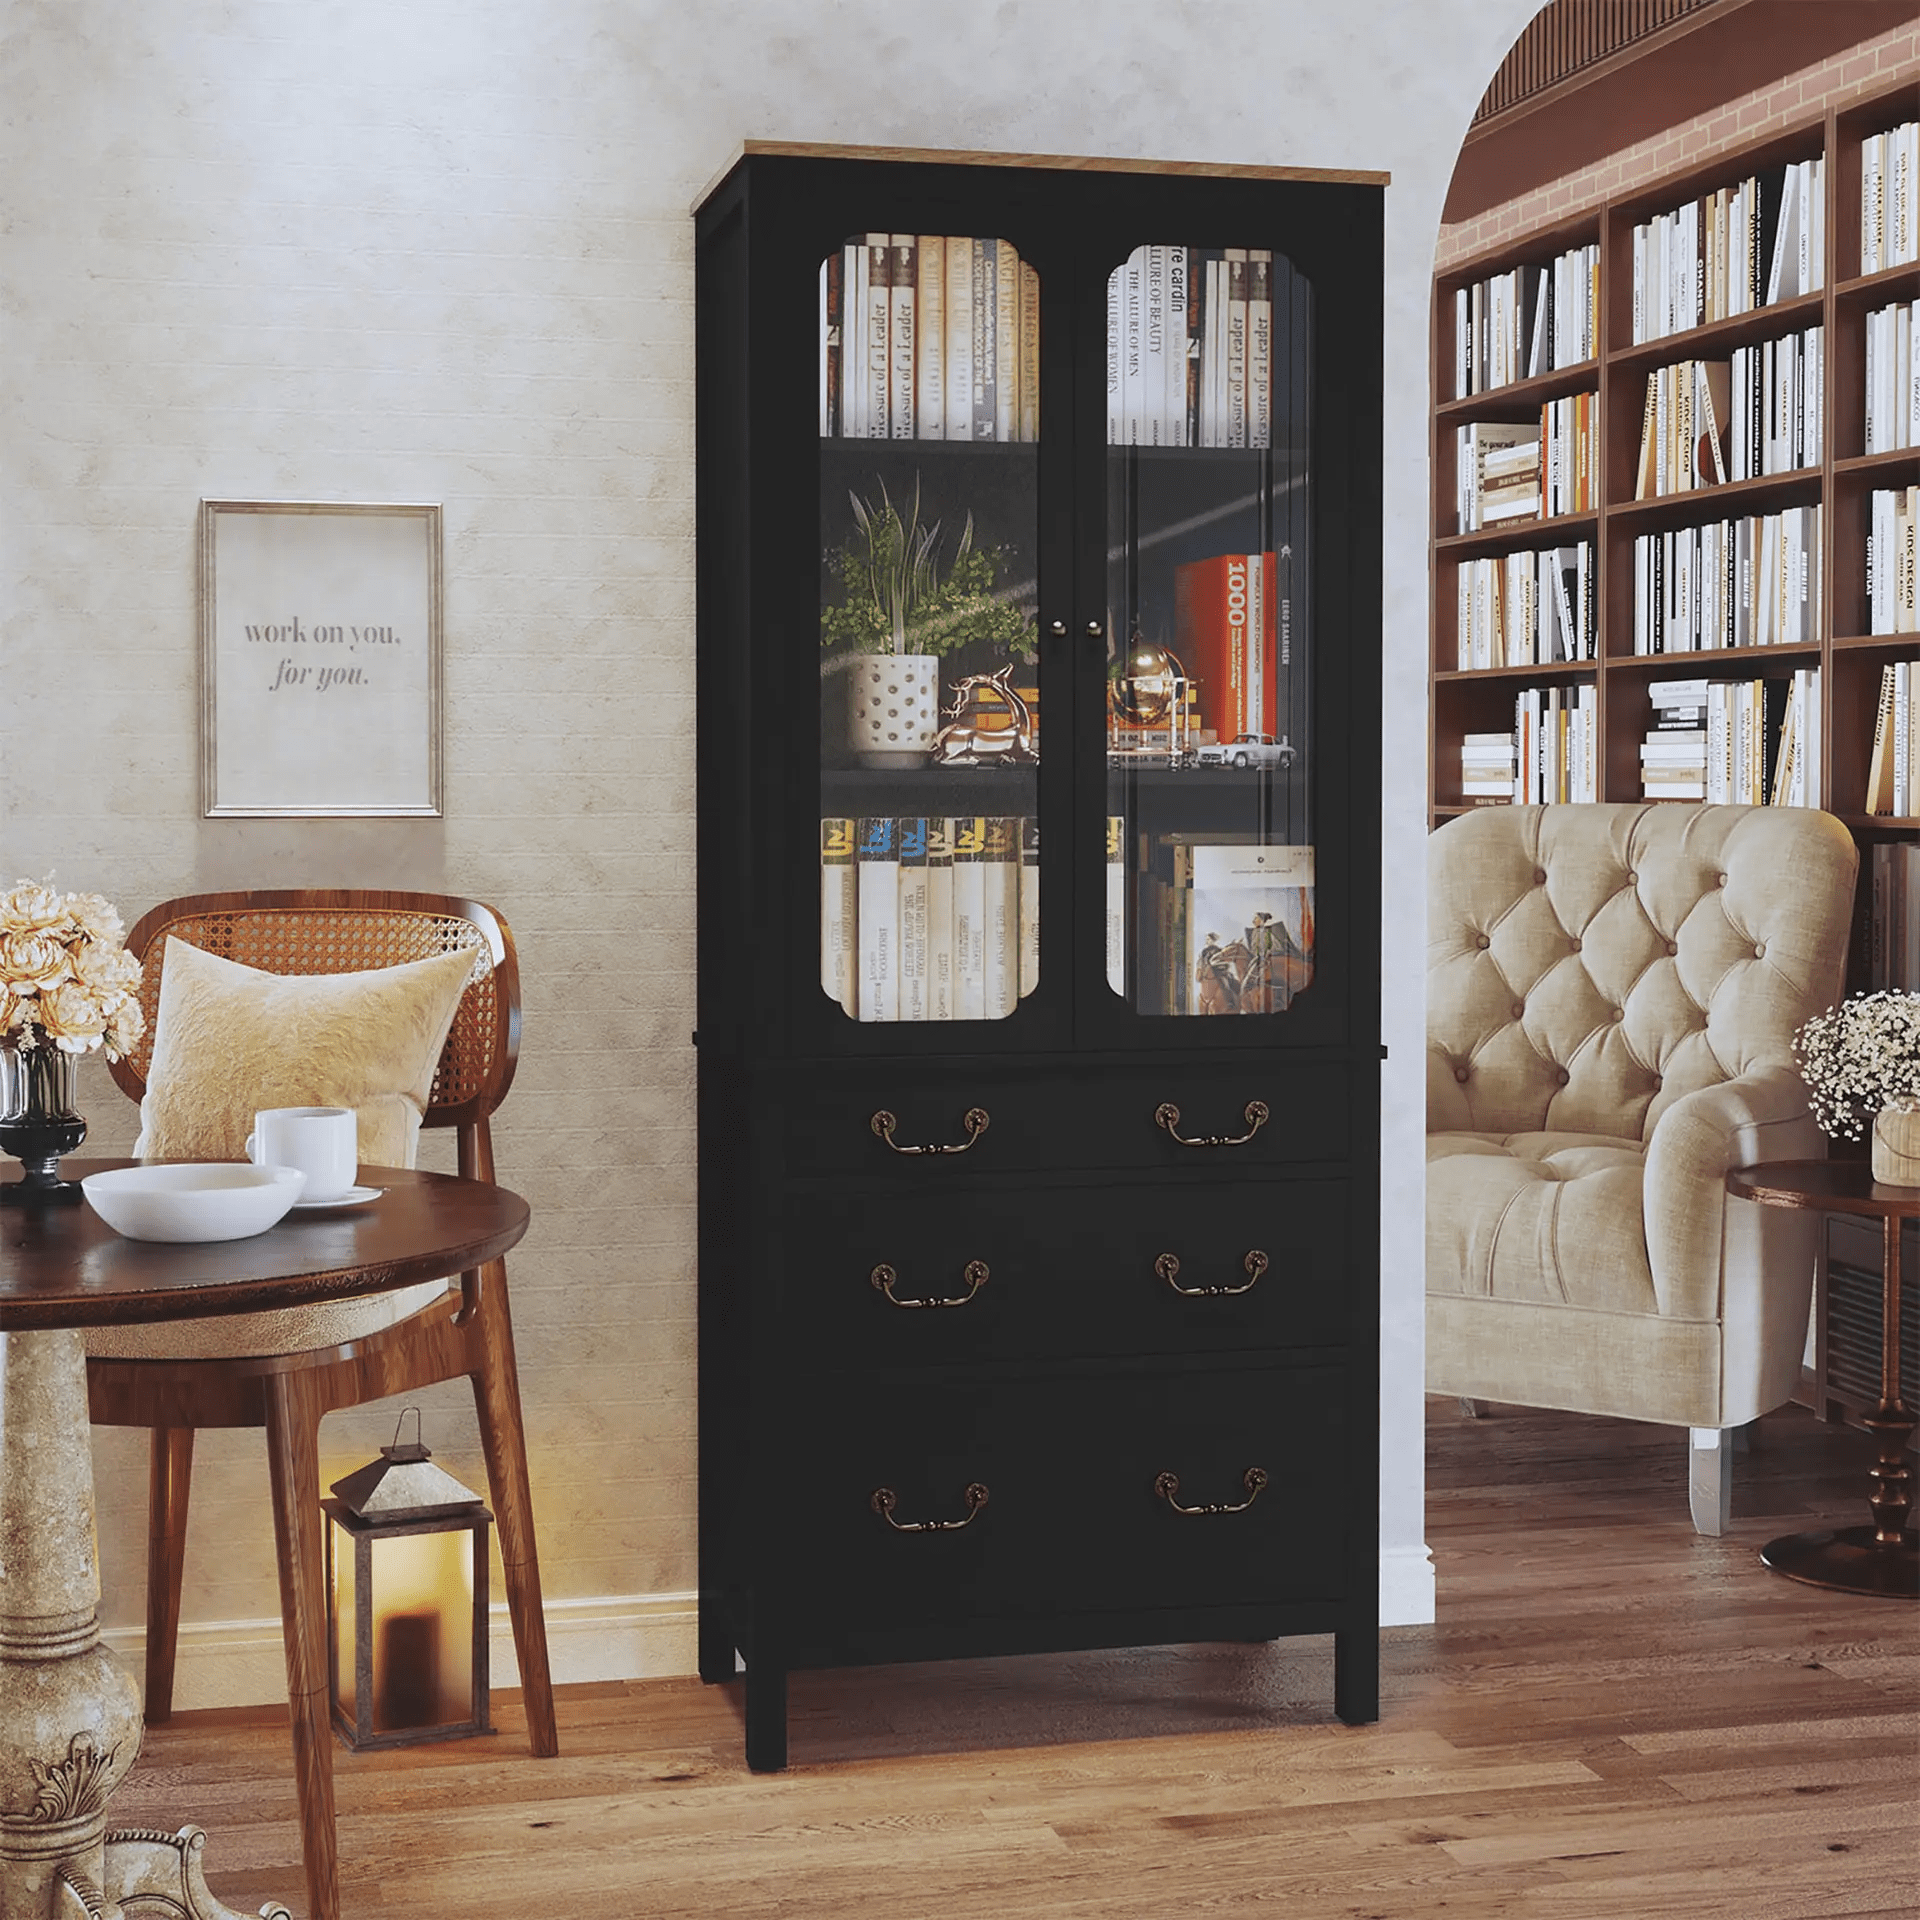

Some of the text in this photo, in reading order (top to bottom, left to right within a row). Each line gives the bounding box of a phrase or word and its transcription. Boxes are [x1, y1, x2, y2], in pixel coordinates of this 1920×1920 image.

[1171, 247, 1186, 264] re
[1129, 268, 1140, 291] THE
[1171, 267, 1187, 313] cardin
[1149, 289, 1162, 306] OF
[1129, 336, 1140, 351] OF
[1149, 307, 1162, 356] BEAUTY
[1129, 352, 1140, 377] MEN
[1906, 525, 1914, 609] KIDS DESIGN
[1227, 562, 1246, 627] 1000
[244, 615, 307, 643] work
[313, 625, 344, 643] on
[268, 658, 369, 692] for you.
